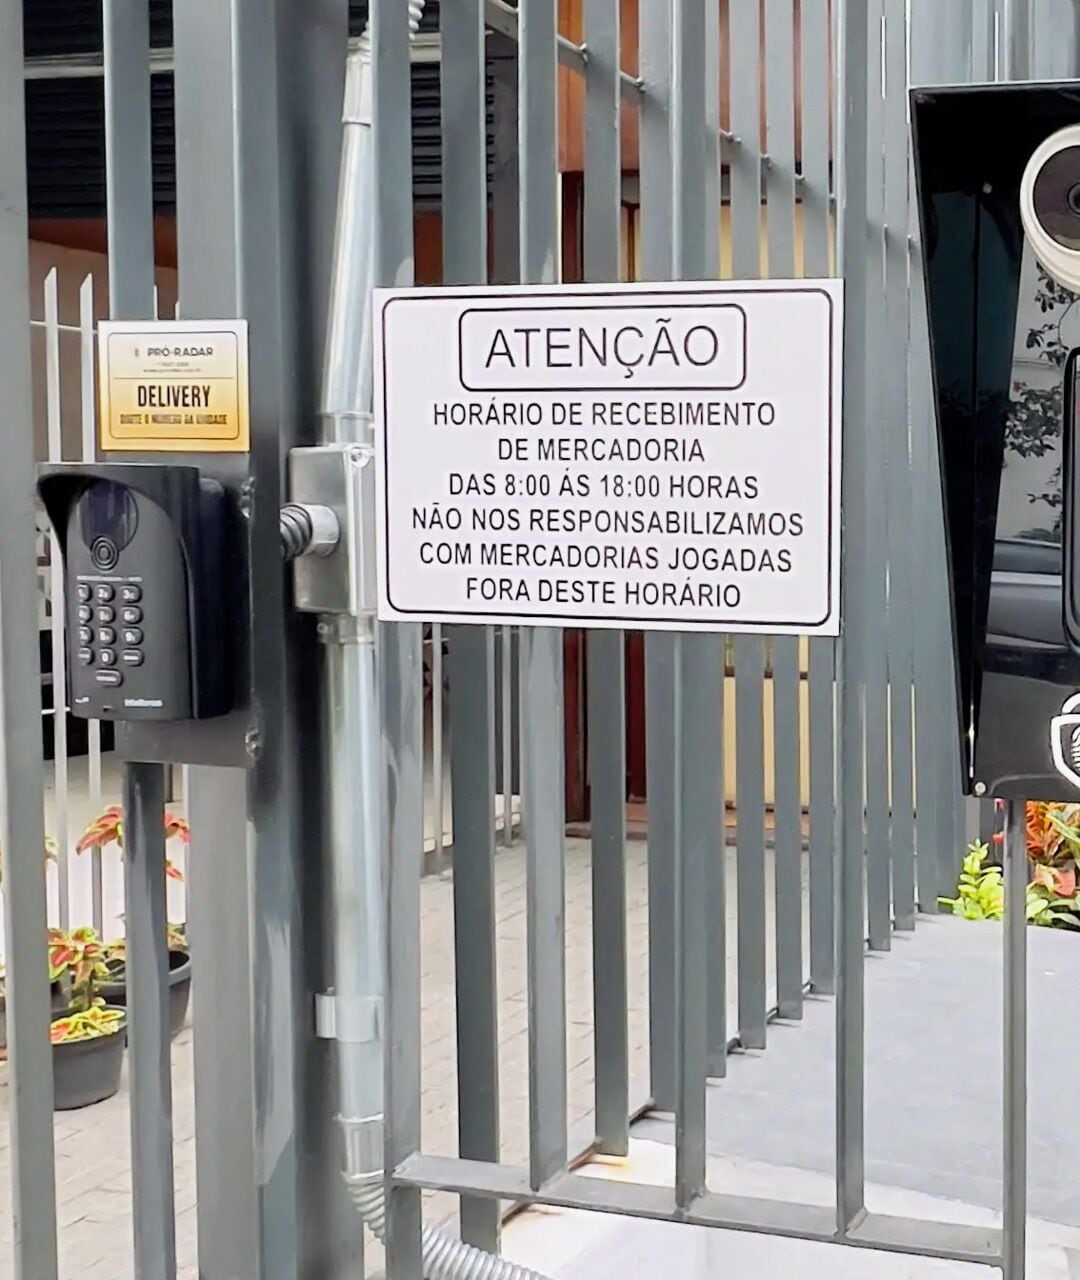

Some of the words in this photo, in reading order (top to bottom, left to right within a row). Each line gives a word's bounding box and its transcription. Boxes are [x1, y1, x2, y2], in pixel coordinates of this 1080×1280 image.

[148, 345, 213, 356] PRÓ-RADAR
[485, 318, 719, 378] ATENÇÃO
[138, 385, 211, 407] DELIVERY
[433, 398, 542, 425] HORÁRIO
[551, 403, 582, 424] DE
[592, 402, 775, 425] RECEBIMENTO
[499, 439, 529, 461] DE
[538, 439, 705, 462] MERCADORIA
[449, 474, 496, 496] DAS
[505, 474, 550, 496] 8:00
[600, 475, 660, 497] 18:00
[669, 476, 758, 499] HORAS
[412, 502, 462, 530] NÃO
[472, 509, 520, 531] NOS
[530, 510, 803, 536] RESPONSABILIZAMOS
[419, 543, 472, 565] COM
[480, 544, 659, 570] MERCADORIAS
[668, 548, 792, 572] JOGADAS
[467, 578, 530, 601] FORA
[539, 580, 615, 605] DESTE
[626, 577, 741, 607] HORÁRIO
